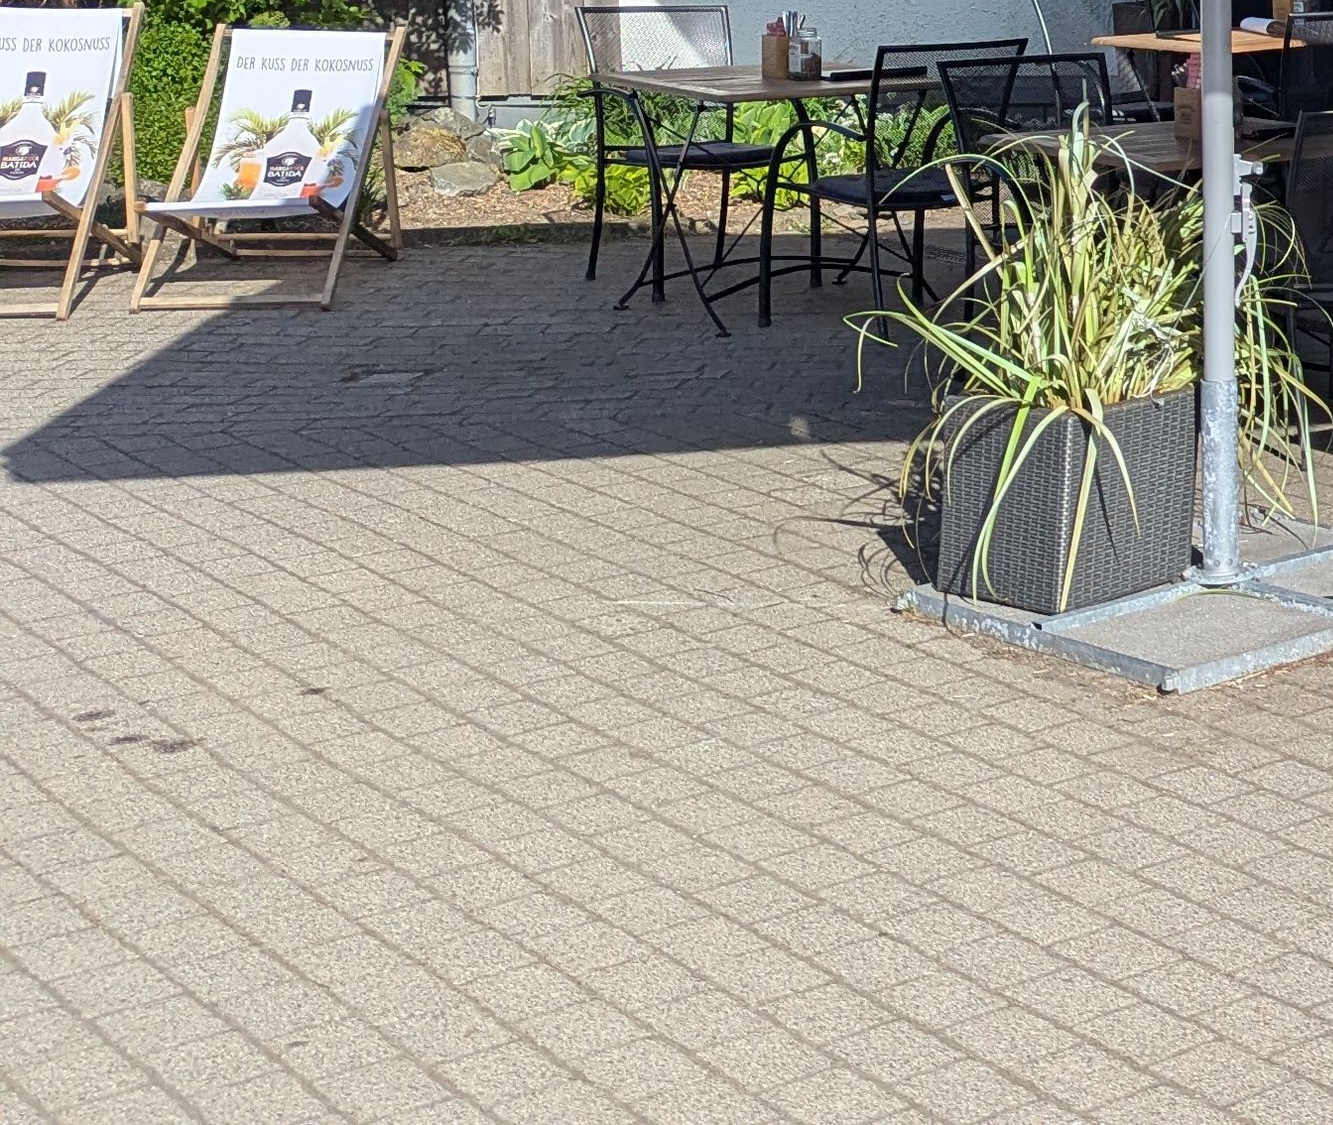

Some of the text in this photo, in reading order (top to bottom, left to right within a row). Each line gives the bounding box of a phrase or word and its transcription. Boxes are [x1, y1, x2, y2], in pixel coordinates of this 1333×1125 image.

[23, 37, 42, 52] DER
[49, 37, 110, 52] KOKOSNUSS
[237, 56, 374, 72] DER KUSS DER KOKOSNUSS
